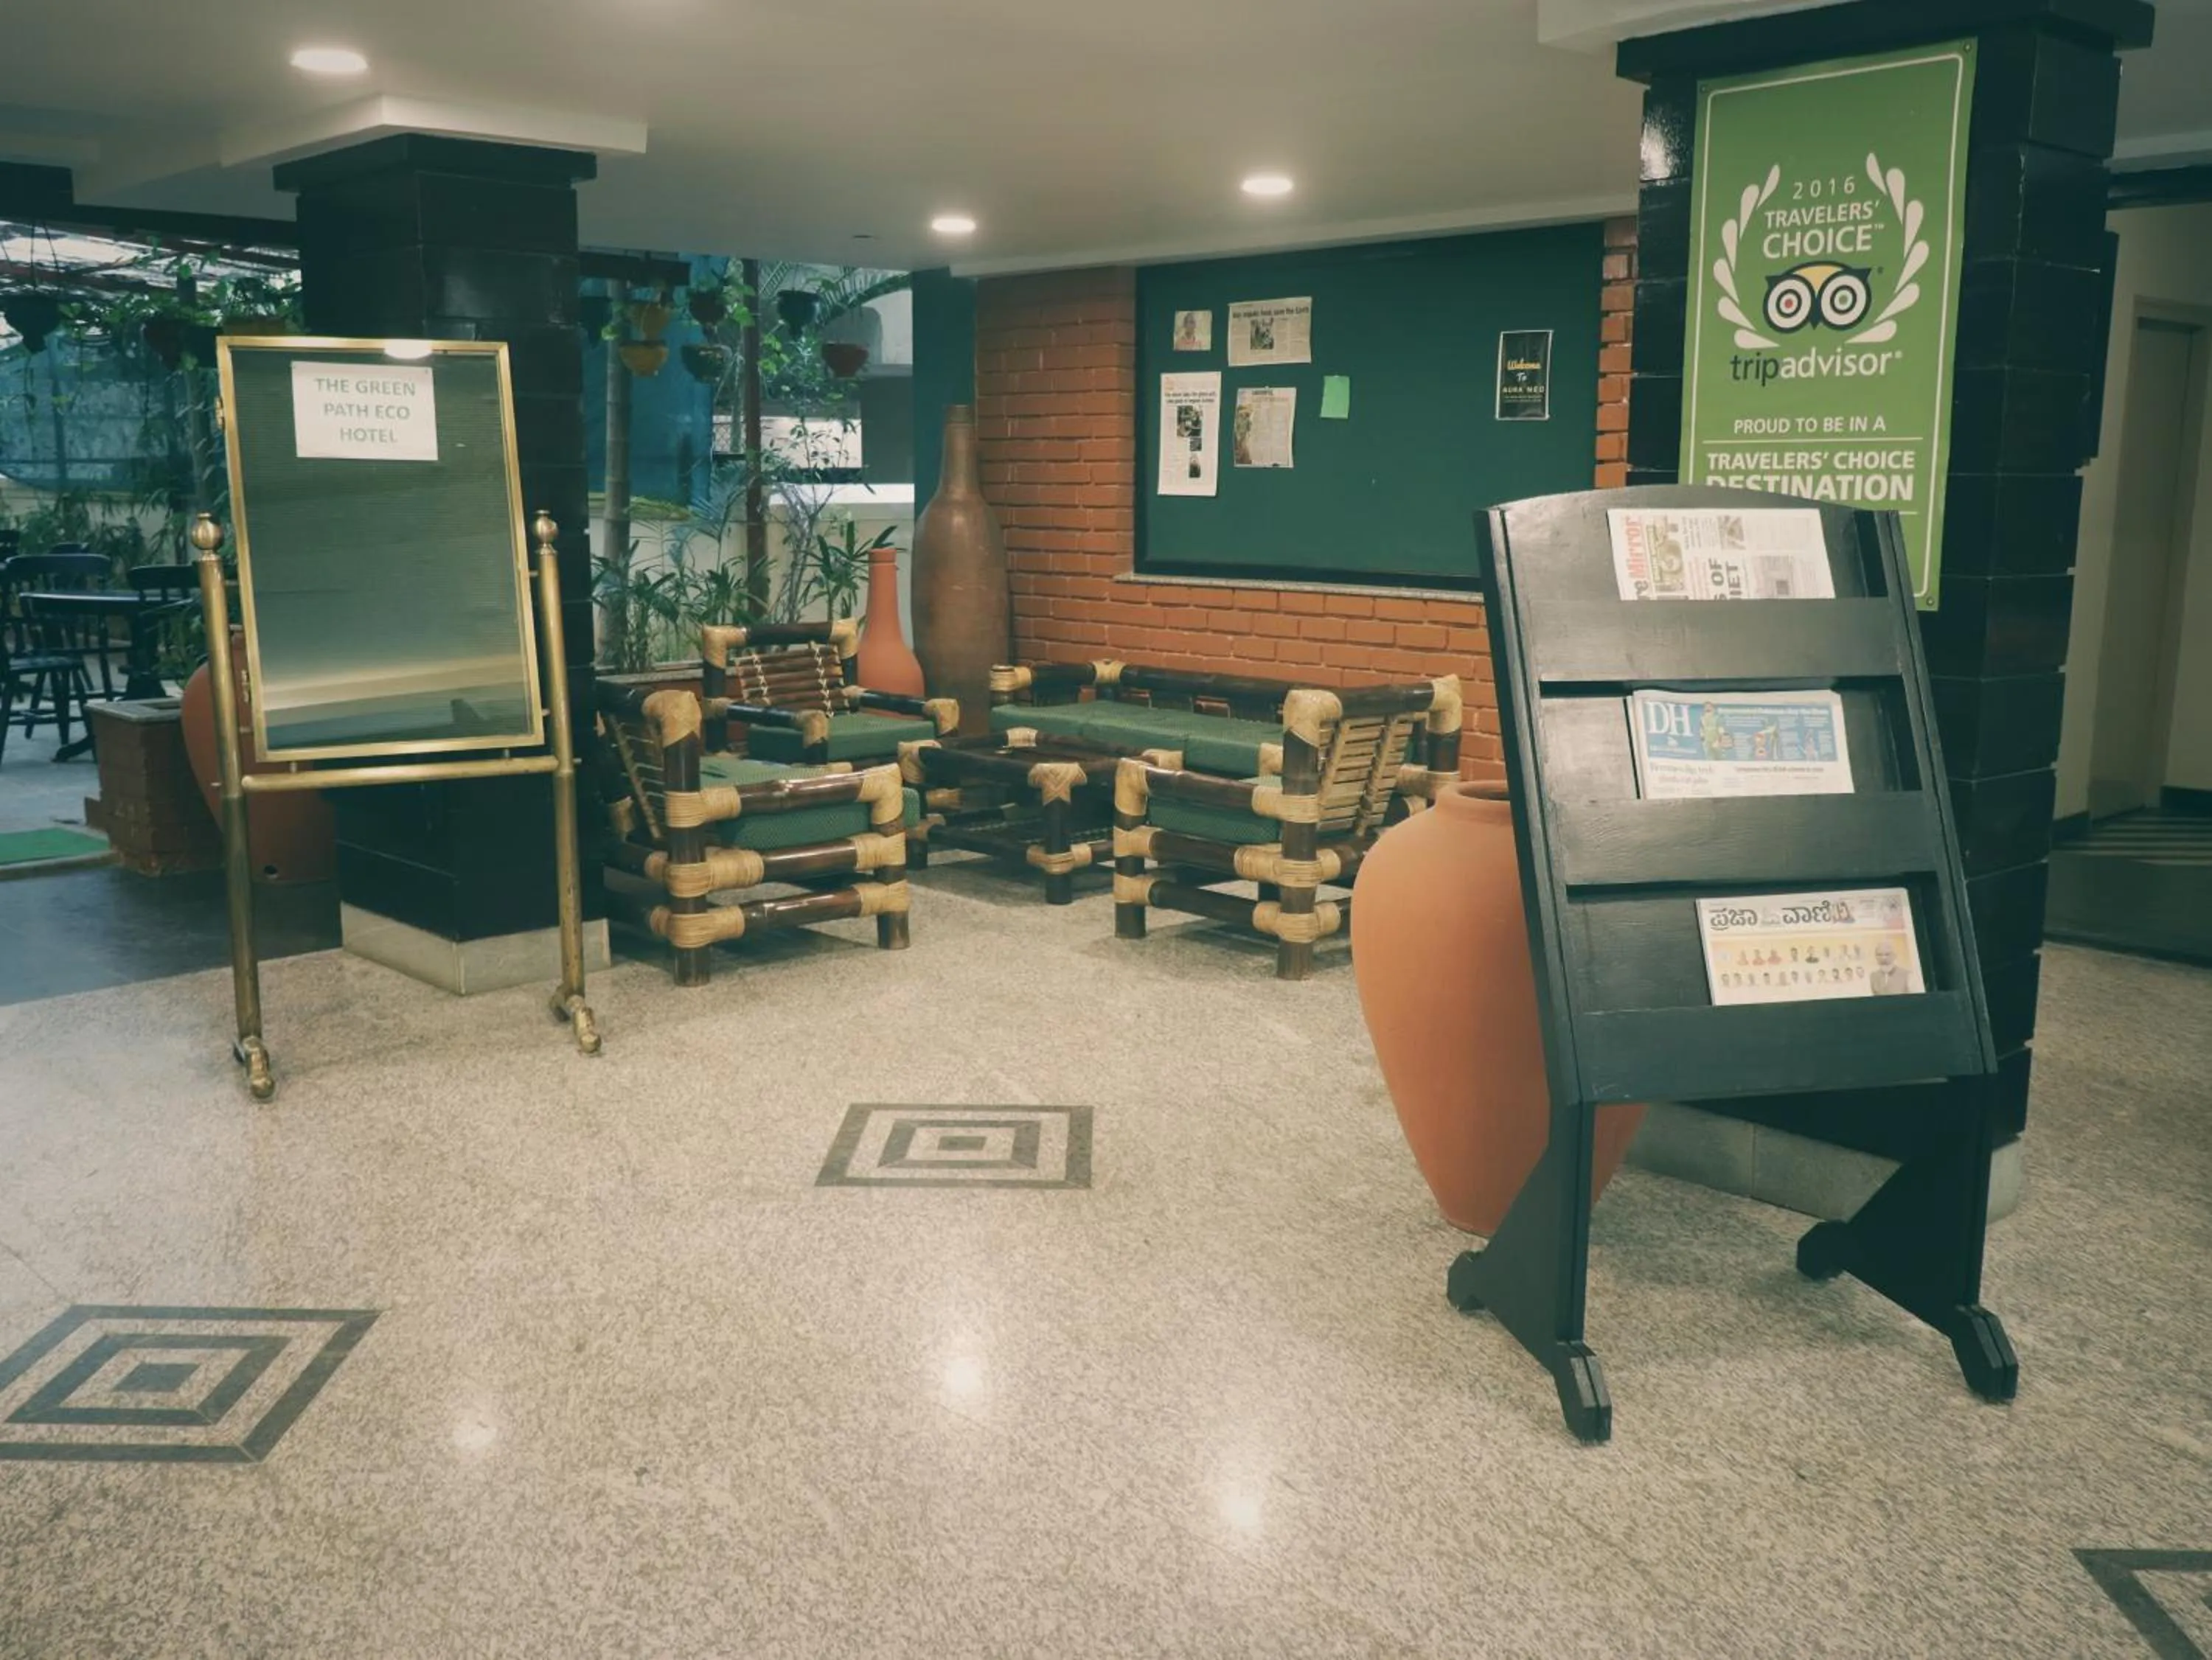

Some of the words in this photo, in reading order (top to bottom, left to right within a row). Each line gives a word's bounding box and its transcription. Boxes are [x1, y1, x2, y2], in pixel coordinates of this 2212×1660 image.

[1792, 177, 1855, 199] 2016
[1730, 346, 1893, 388] tripadvisor
[315, 378, 349, 393] THE
[355, 380, 416, 397] GREEN
[324, 402, 368, 419] PATH
[375, 405, 410, 419] ECO
[1734, 418, 1790, 434] PROUD
[1795, 417, 1818, 433] TO
[1823, 416, 1845, 433] BE
[1849, 416, 1868, 432] IN
[1872, 415, 1886, 432] A
[340, 428, 398, 443] HOTEL
[1833, 450, 1916, 470] CHOICE
[1644, 701, 1694, 736] DH
